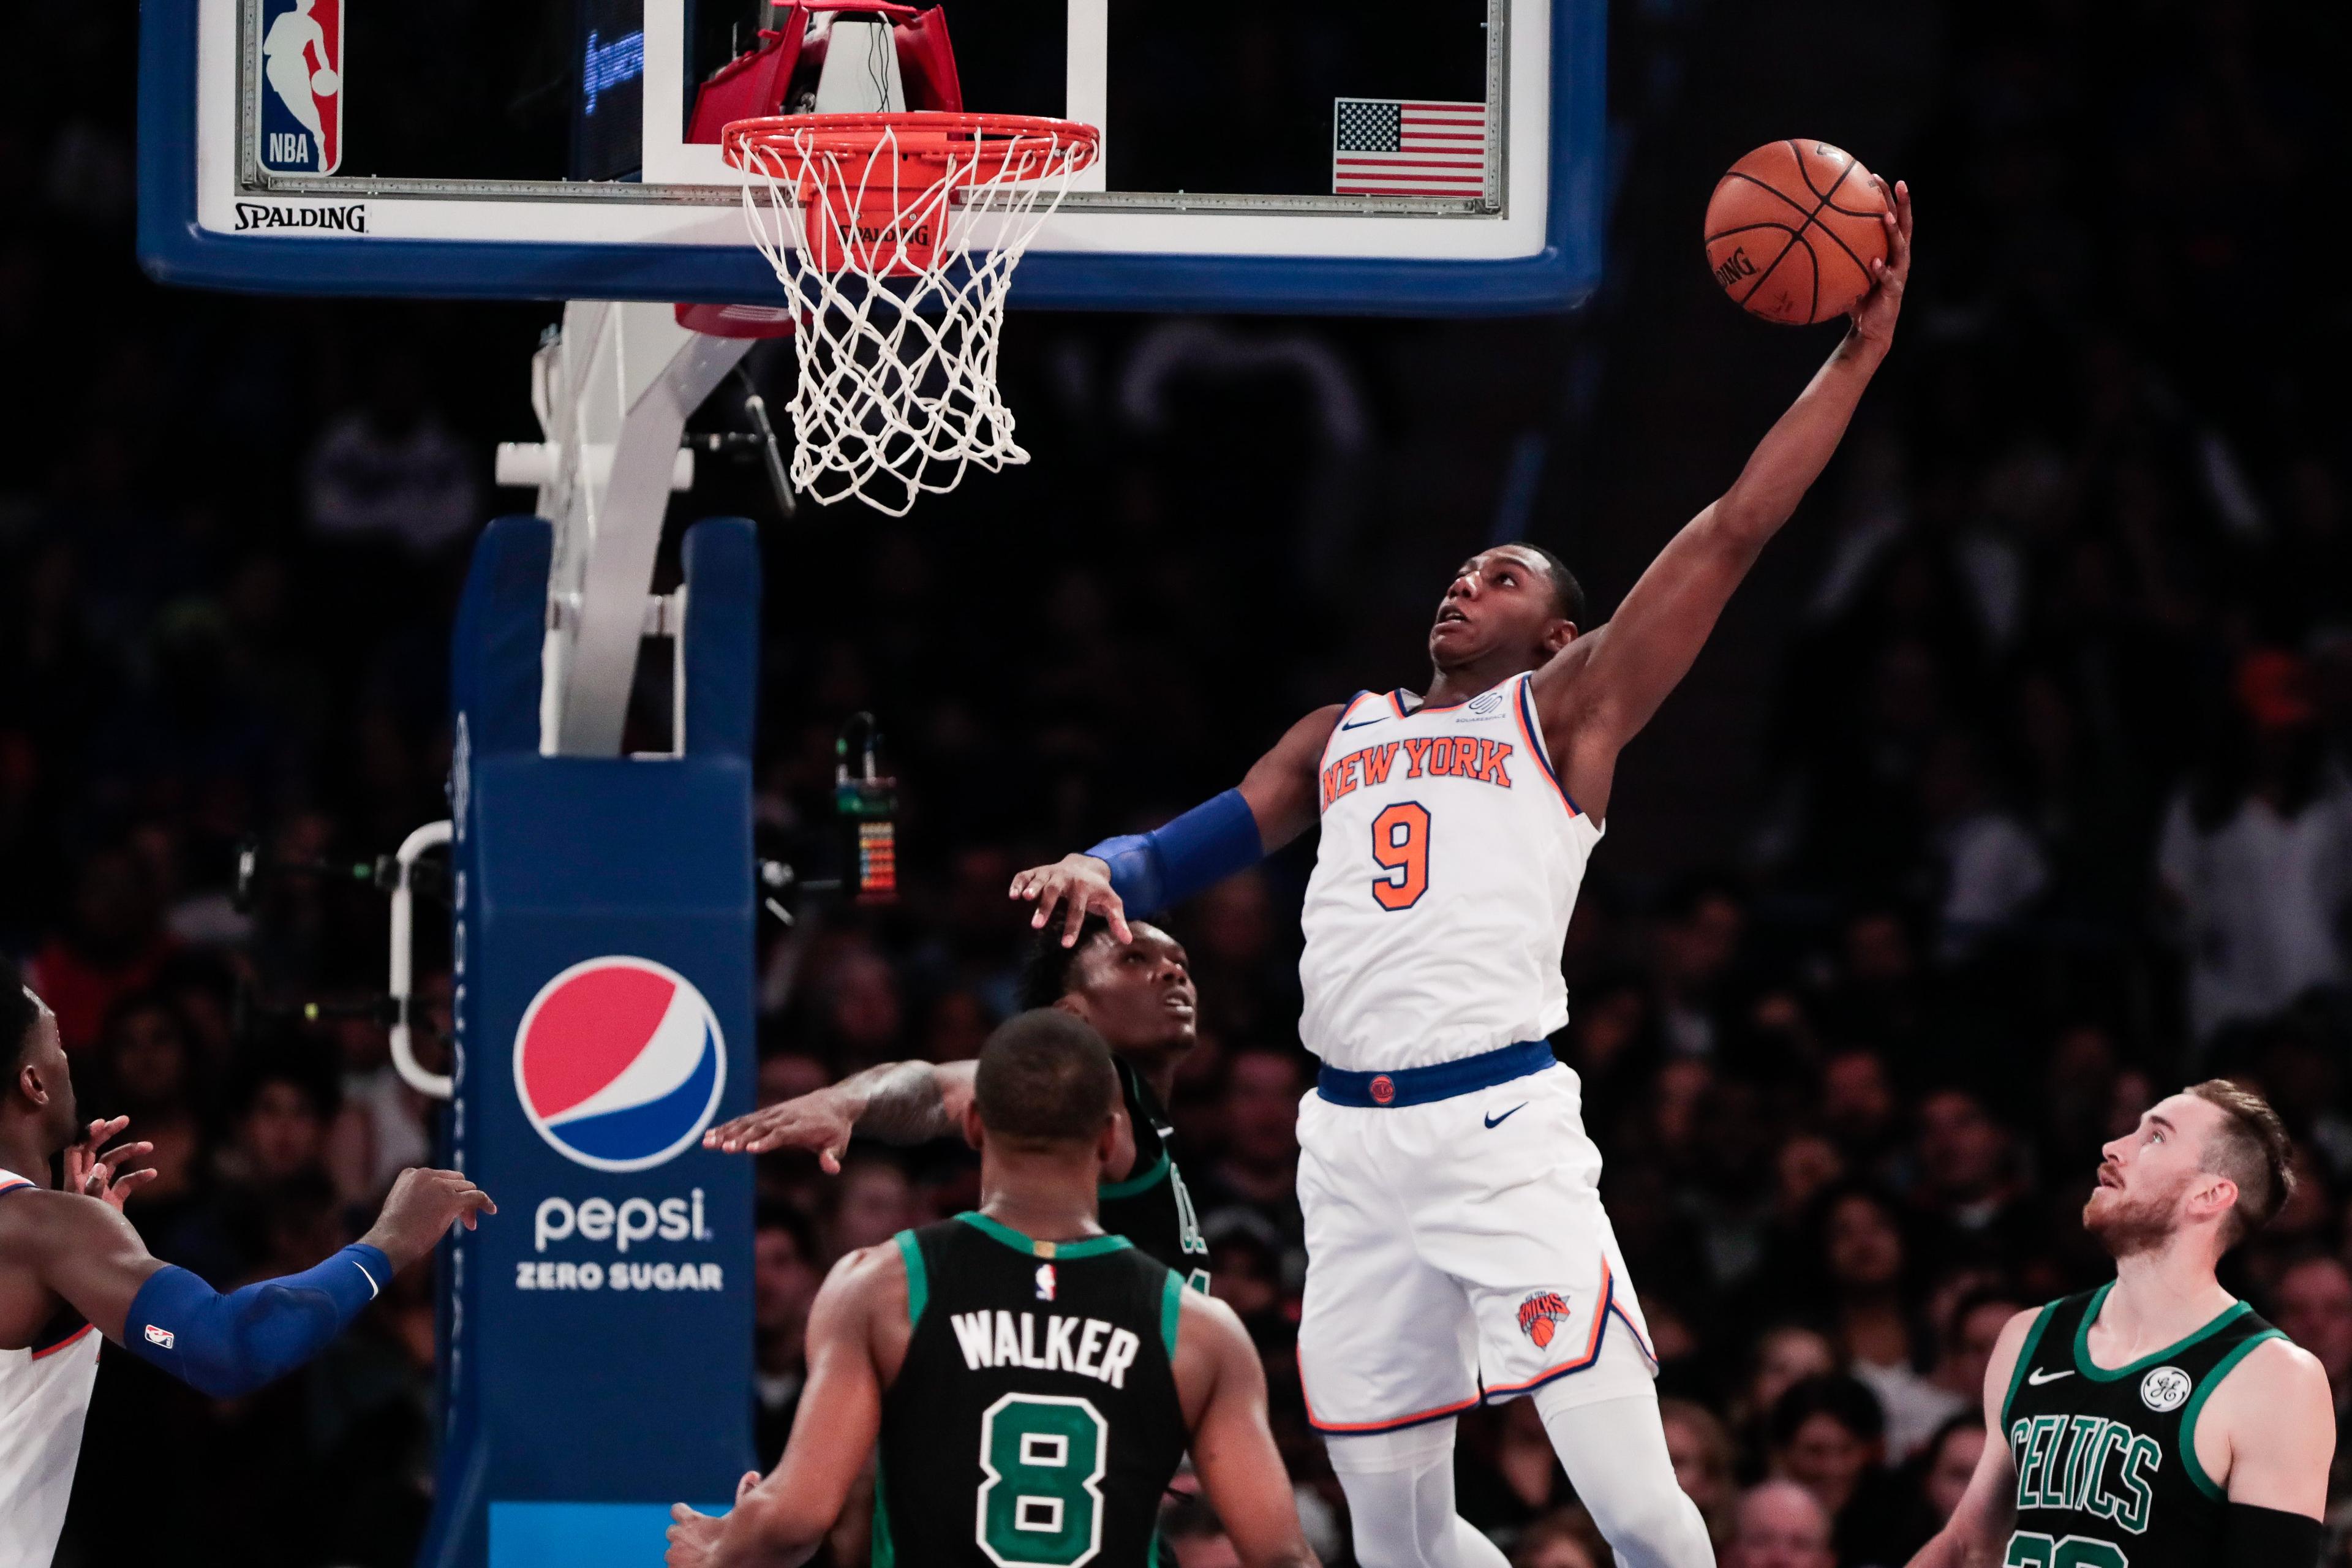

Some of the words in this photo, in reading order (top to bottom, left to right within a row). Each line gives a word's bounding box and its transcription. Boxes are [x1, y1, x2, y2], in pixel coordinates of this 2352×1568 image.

[270, 132, 309, 164] NBA
[235, 202, 366, 233] SPALDING
[839, 224, 930, 246] SPALDNG
[1321, 741, 1400, 816] NEW
[1403, 735, 1515, 790] YORK
[1371, 801, 1431, 911] 9
[535, 1187, 705, 1254] pepsi
[516, 1262, 604, 1291] ZERO
[608, 1262, 725, 1292] SUGAR
[950, 1310, 1141, 1389] WALKER
[975, 1392, 1109, 1568] 8
[2011, 1414, 2162, 1535] CELTICS
